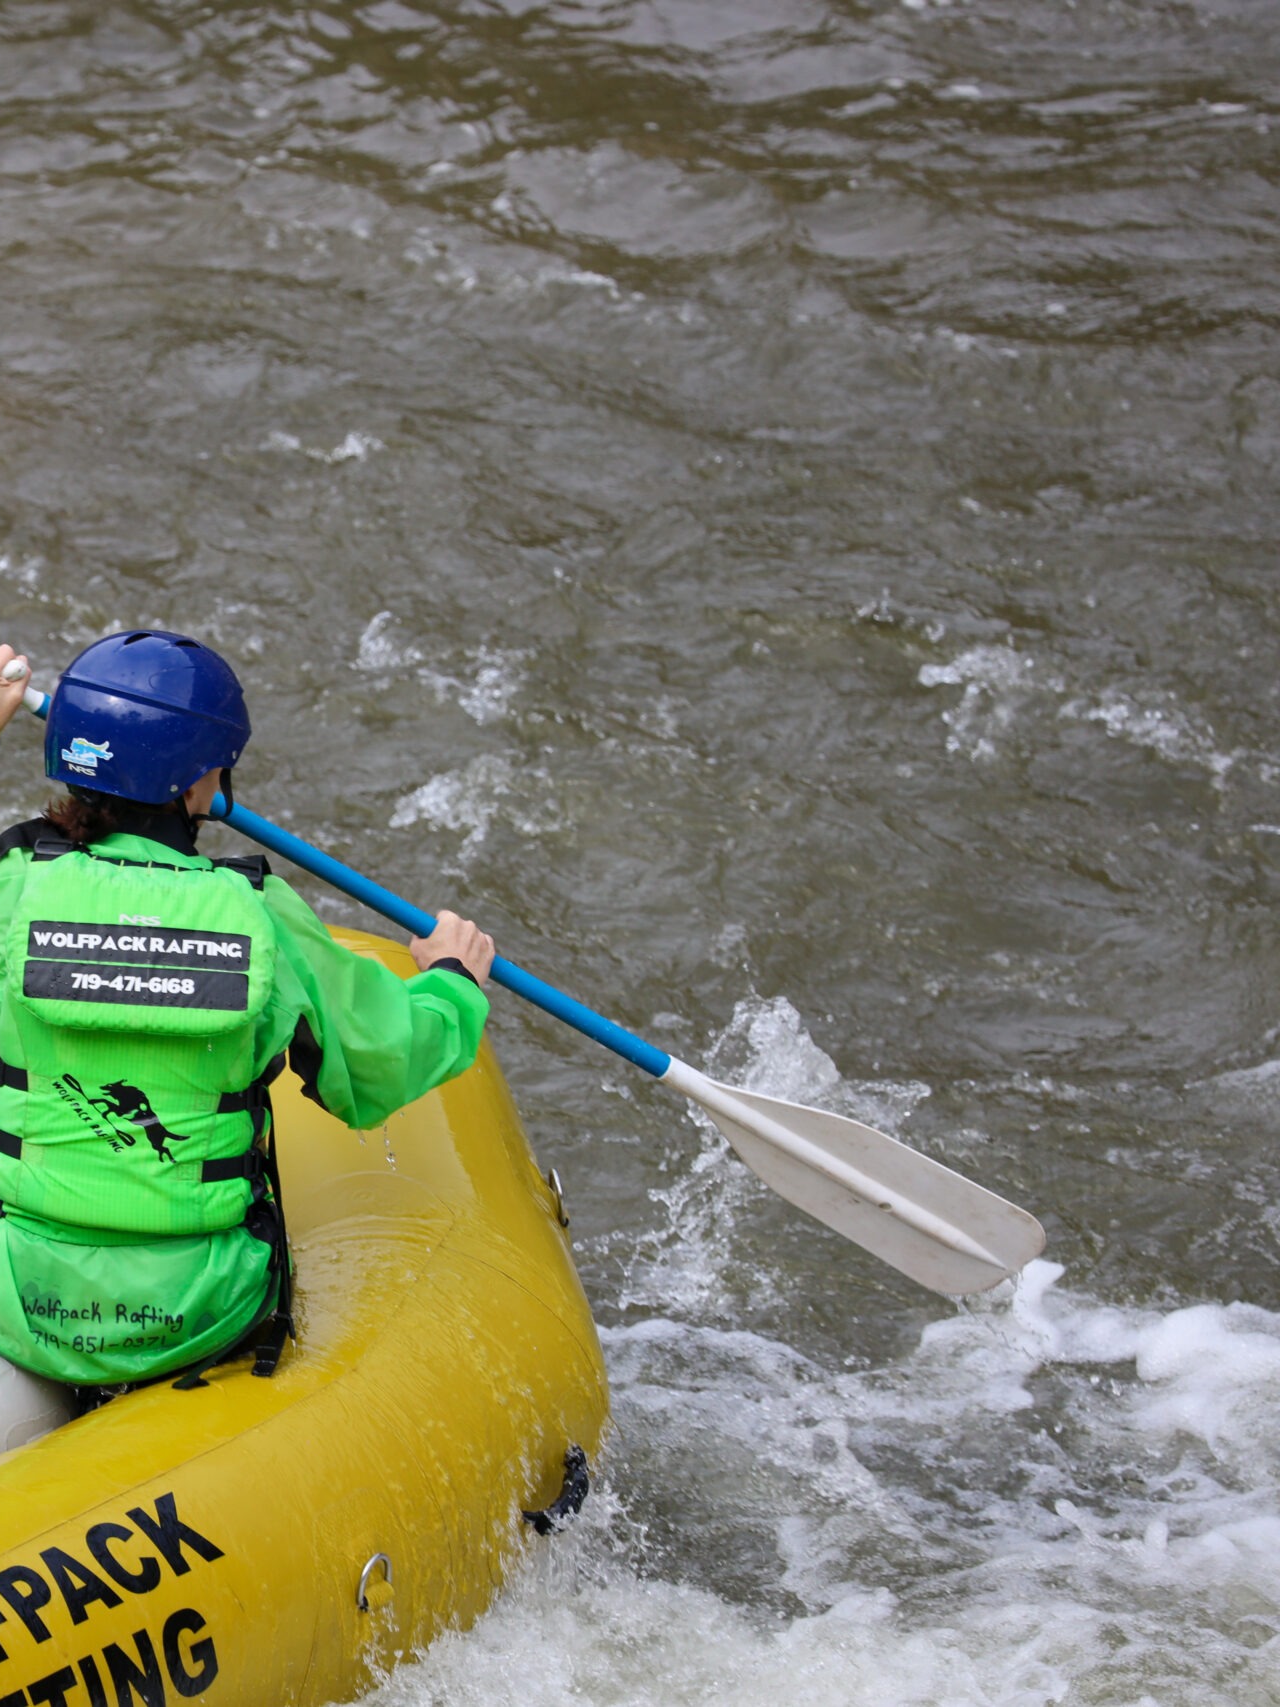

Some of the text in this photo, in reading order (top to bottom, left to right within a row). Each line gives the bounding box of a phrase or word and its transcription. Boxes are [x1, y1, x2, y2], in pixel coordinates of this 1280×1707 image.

[68, 762, 97, 777] NRS
[119, 913, 162, 927] NRS
[33, 931, 243, 958] WOLFPACK RAFTING
[71, 973, 196, 995] 719-471-6168
[21, 1296, 184, 1333] Wolfpack Rafting
